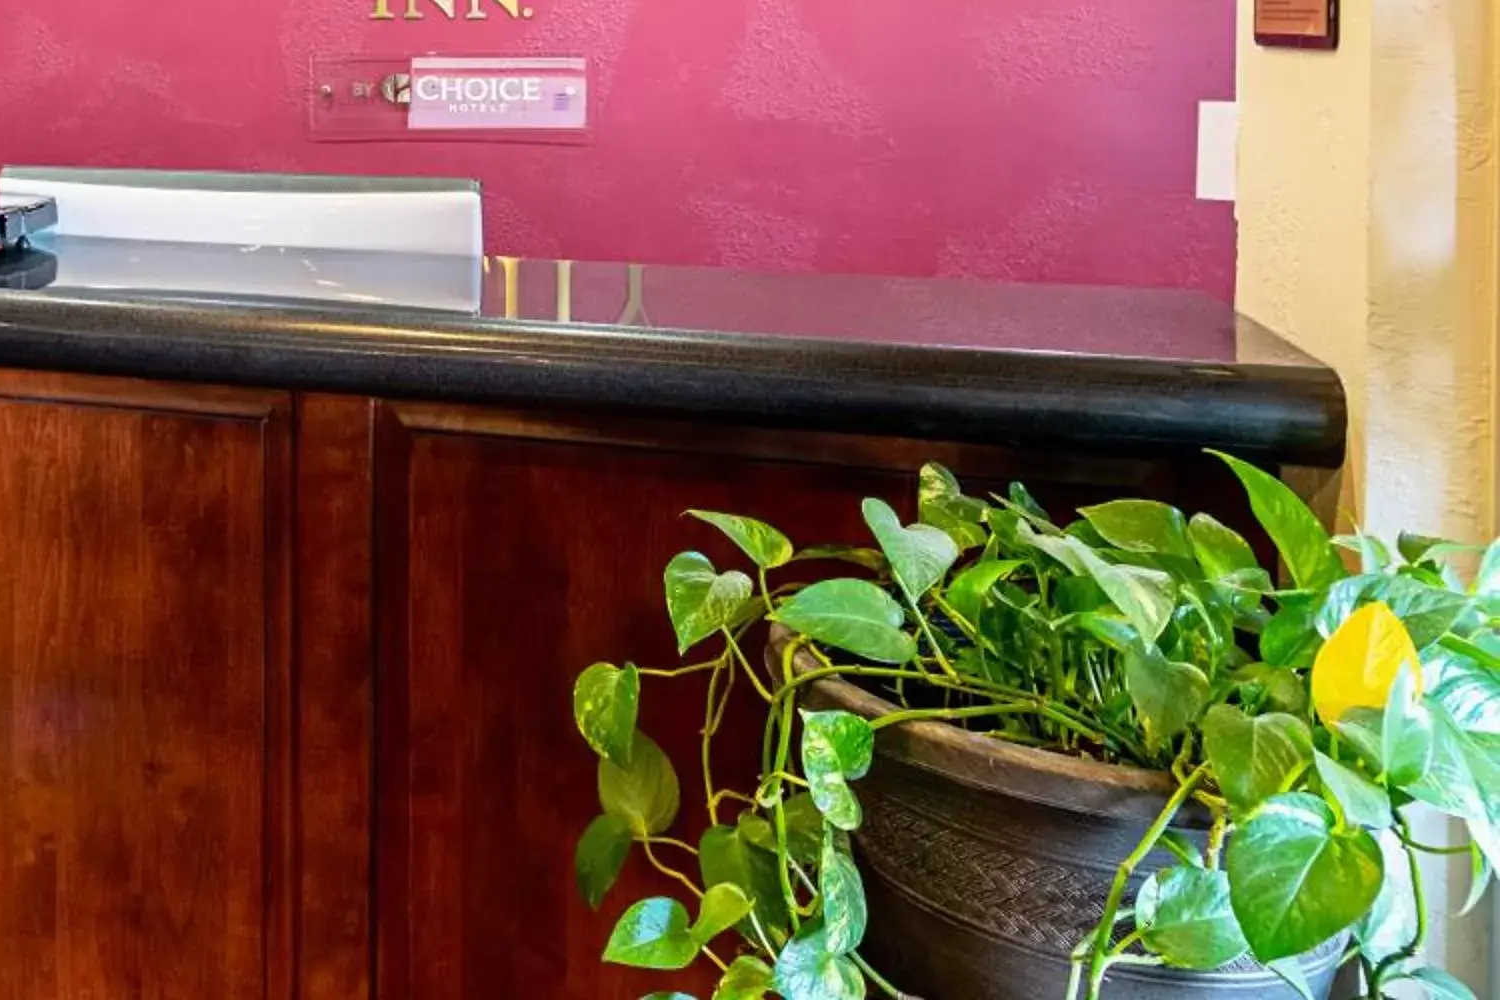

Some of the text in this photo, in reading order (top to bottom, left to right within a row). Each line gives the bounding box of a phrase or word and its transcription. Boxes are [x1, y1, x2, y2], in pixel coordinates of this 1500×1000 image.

[352, 74, 543, 102] BY CHOICE
[449, 103, 509, 114] HOTELS
